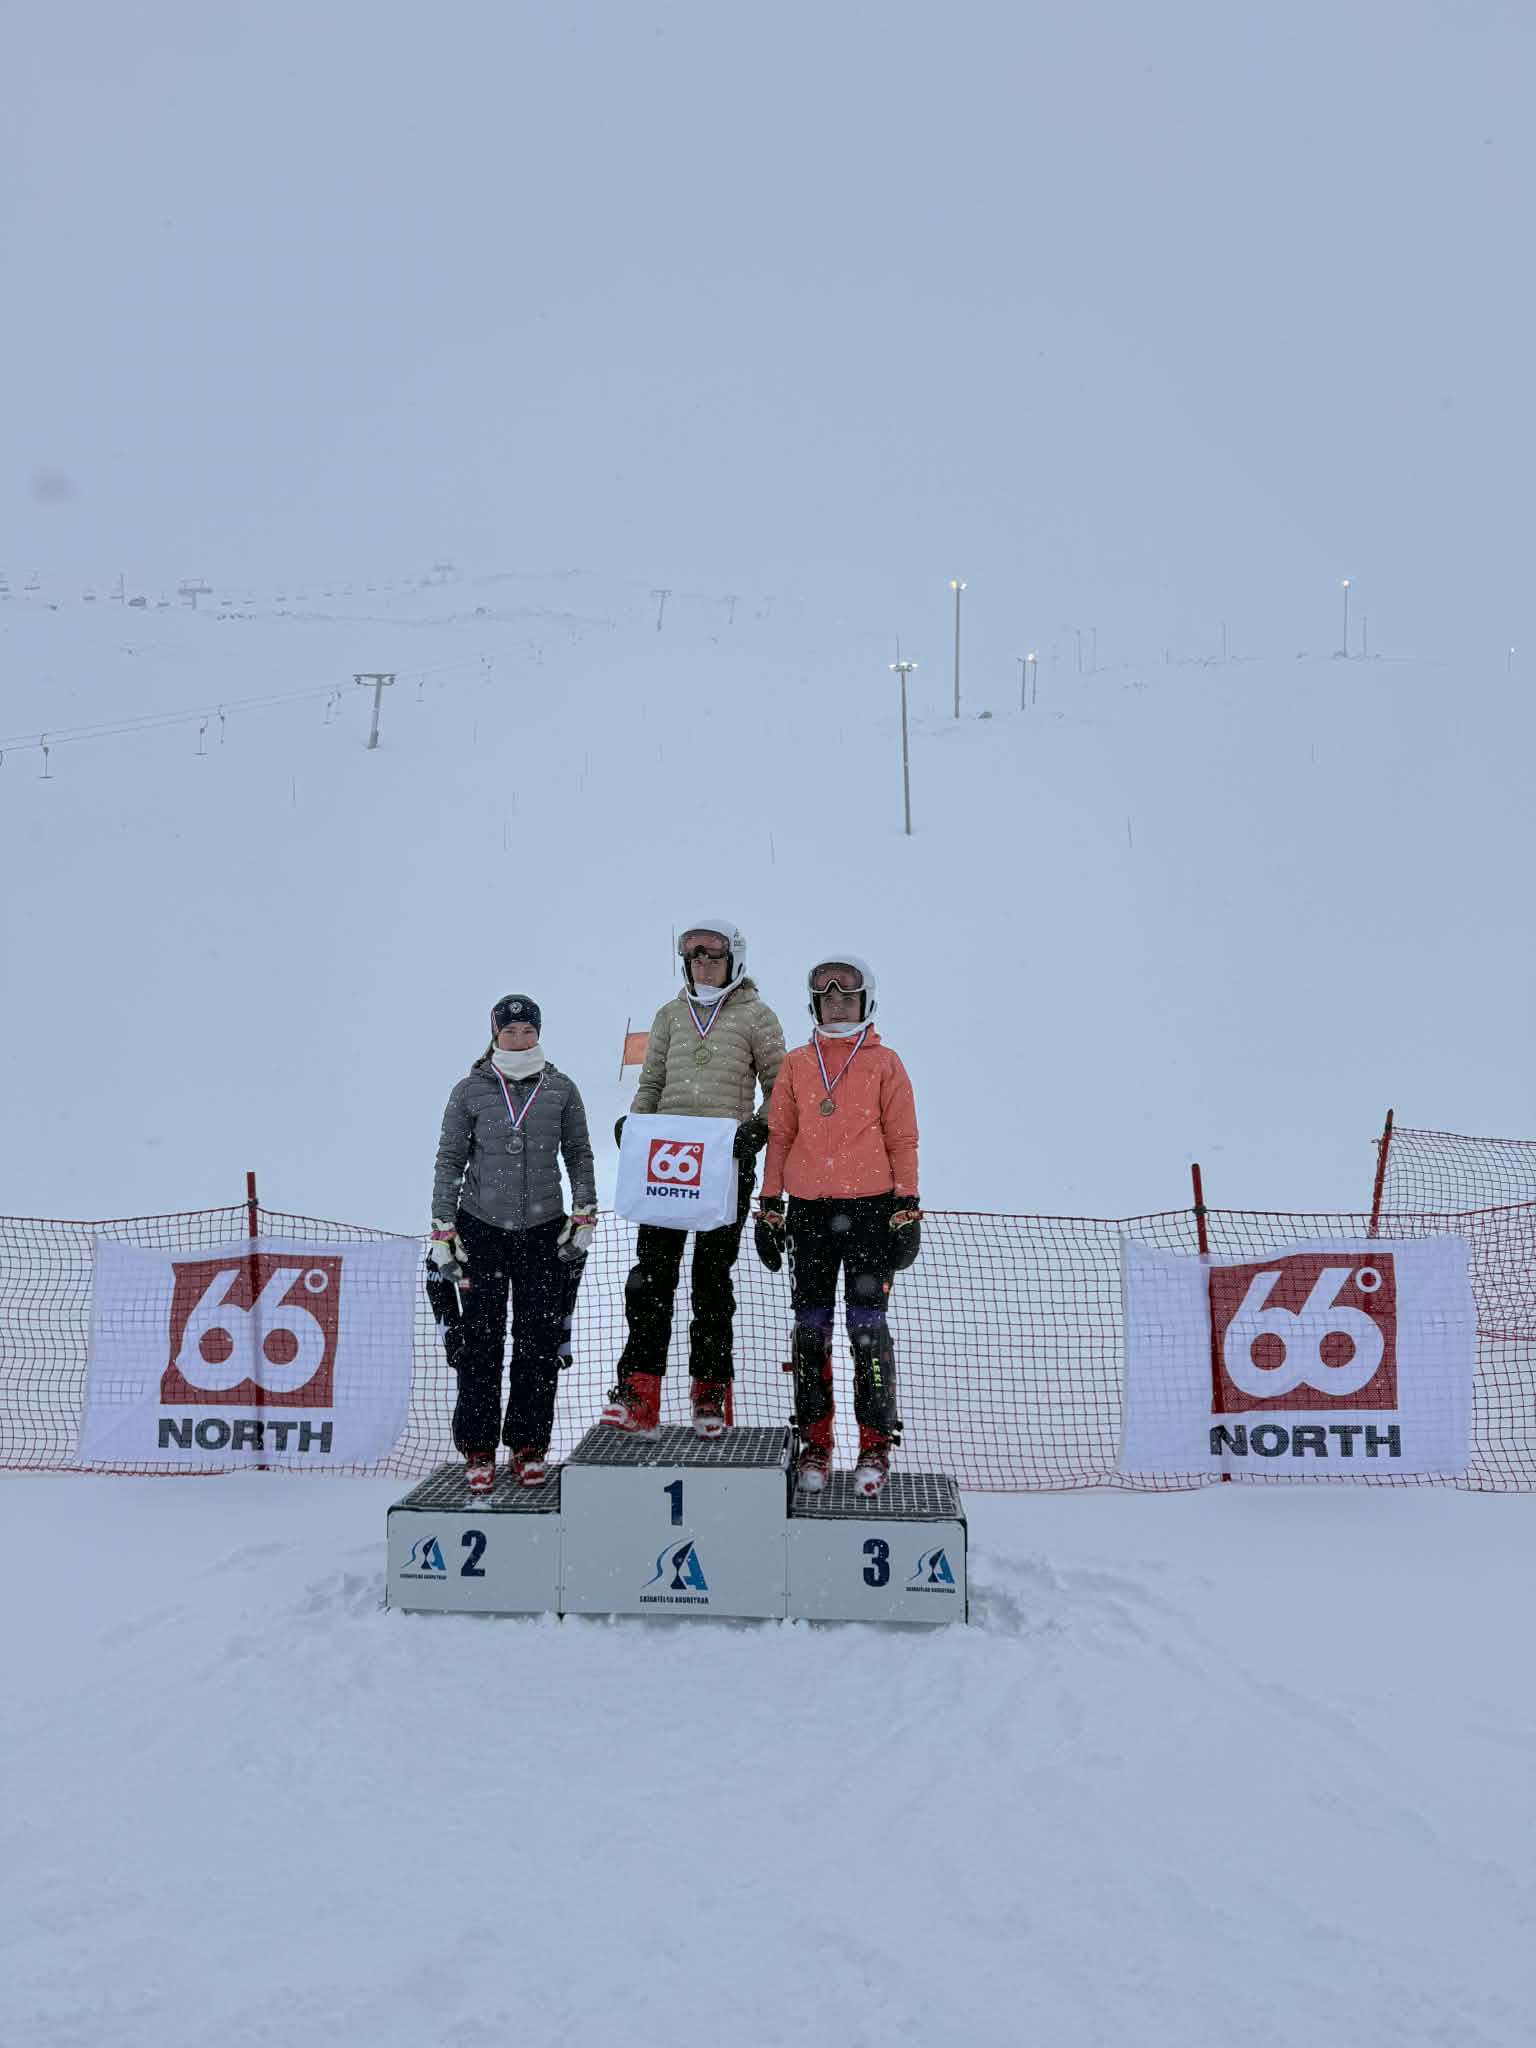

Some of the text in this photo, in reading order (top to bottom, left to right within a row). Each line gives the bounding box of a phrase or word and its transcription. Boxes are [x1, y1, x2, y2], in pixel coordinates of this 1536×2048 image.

[646, 1187, 700, 1199] NORTH
[158, 1418, 333, 1453] NORTH
[1209, 1424, 1401, 1458] NORTH
[664, 1479, 683, 1526] 1
[460, 1530, 487, 1577] 2
[863, 1538, 890, 1587] 3
